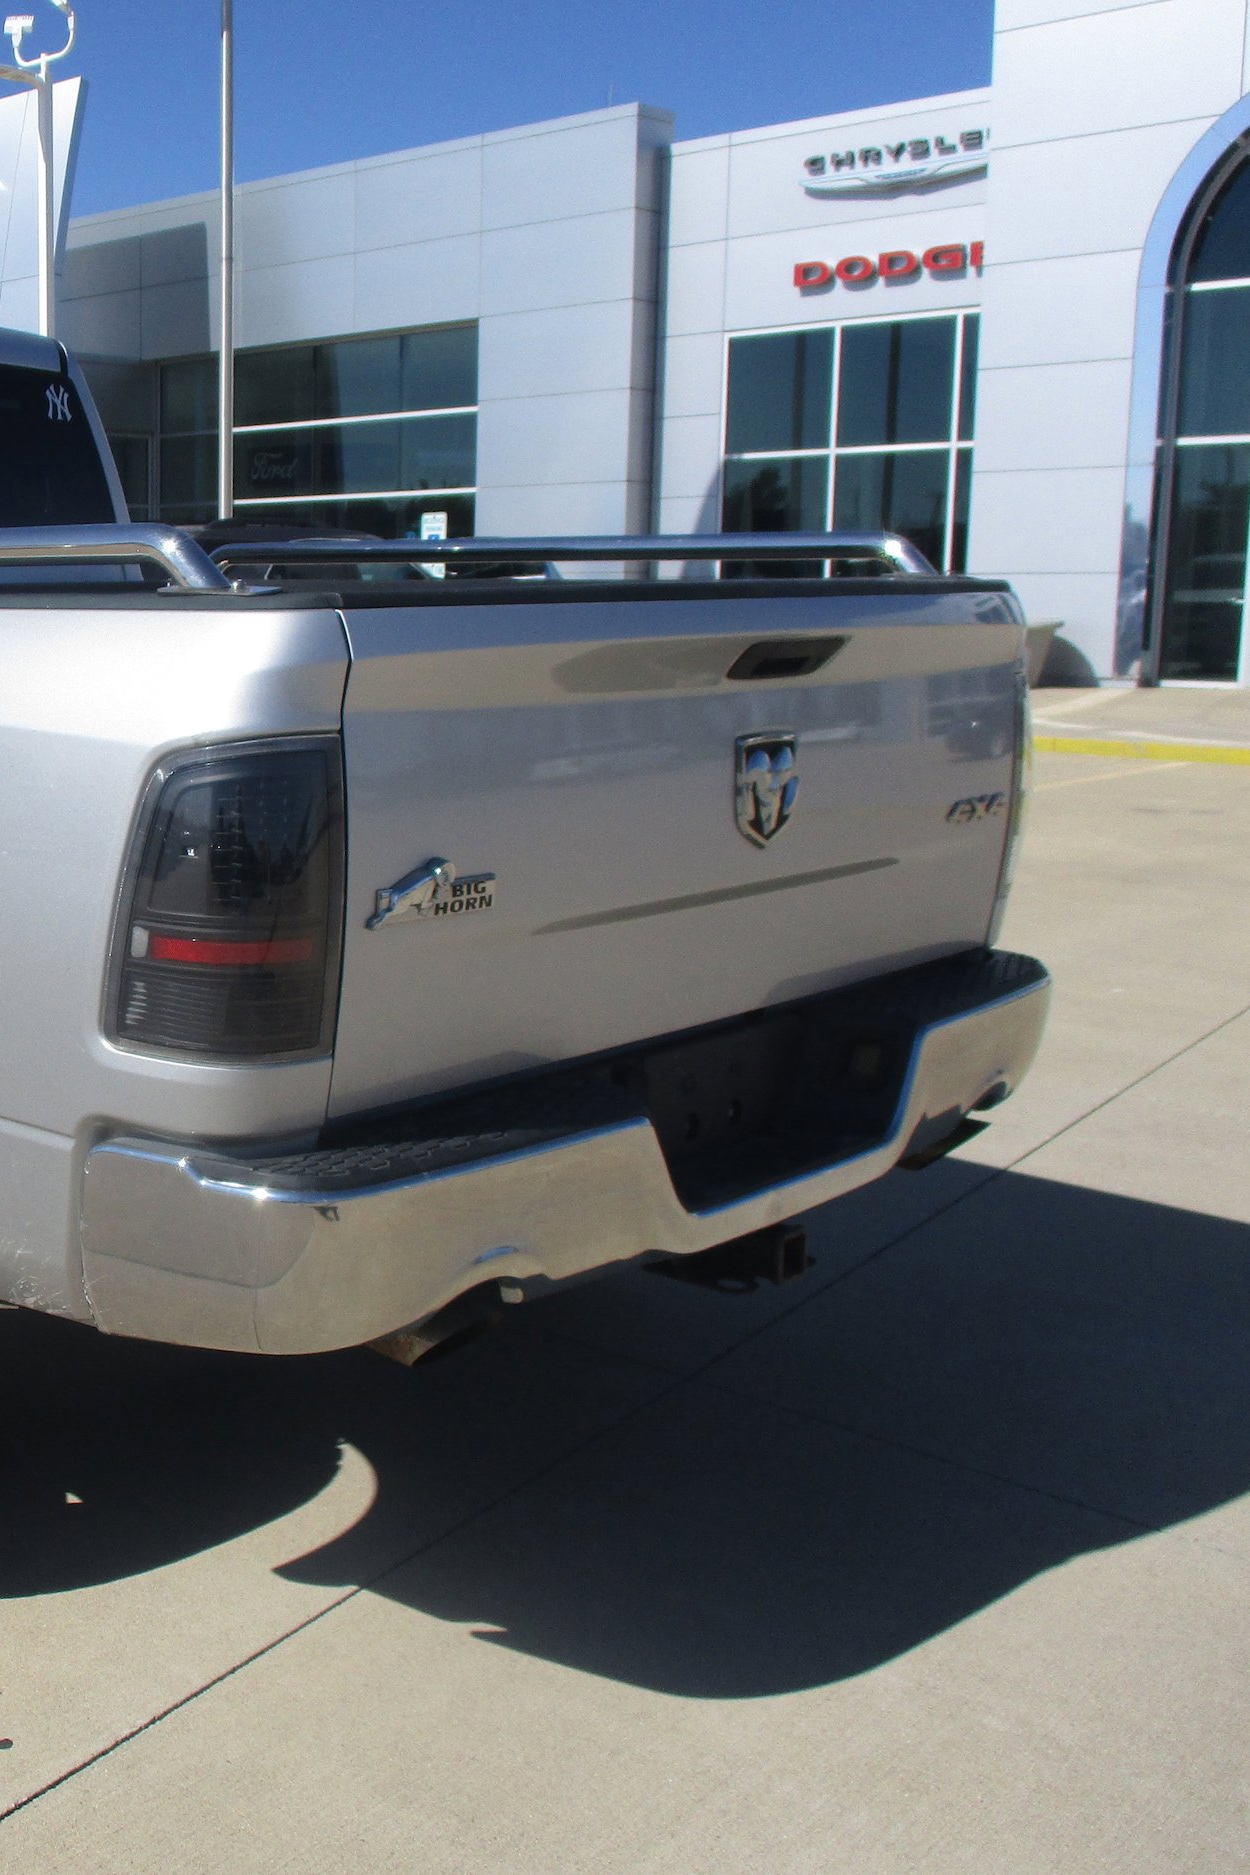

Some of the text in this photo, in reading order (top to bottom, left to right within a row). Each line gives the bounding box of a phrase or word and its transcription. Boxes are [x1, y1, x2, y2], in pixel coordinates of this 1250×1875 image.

[804, 128, 990, 175] CHRYSLE
[252, 451, 299, 480] Ford
[451, 880, 486, 898] BIG
[433, 895, 493, 916] HORN
